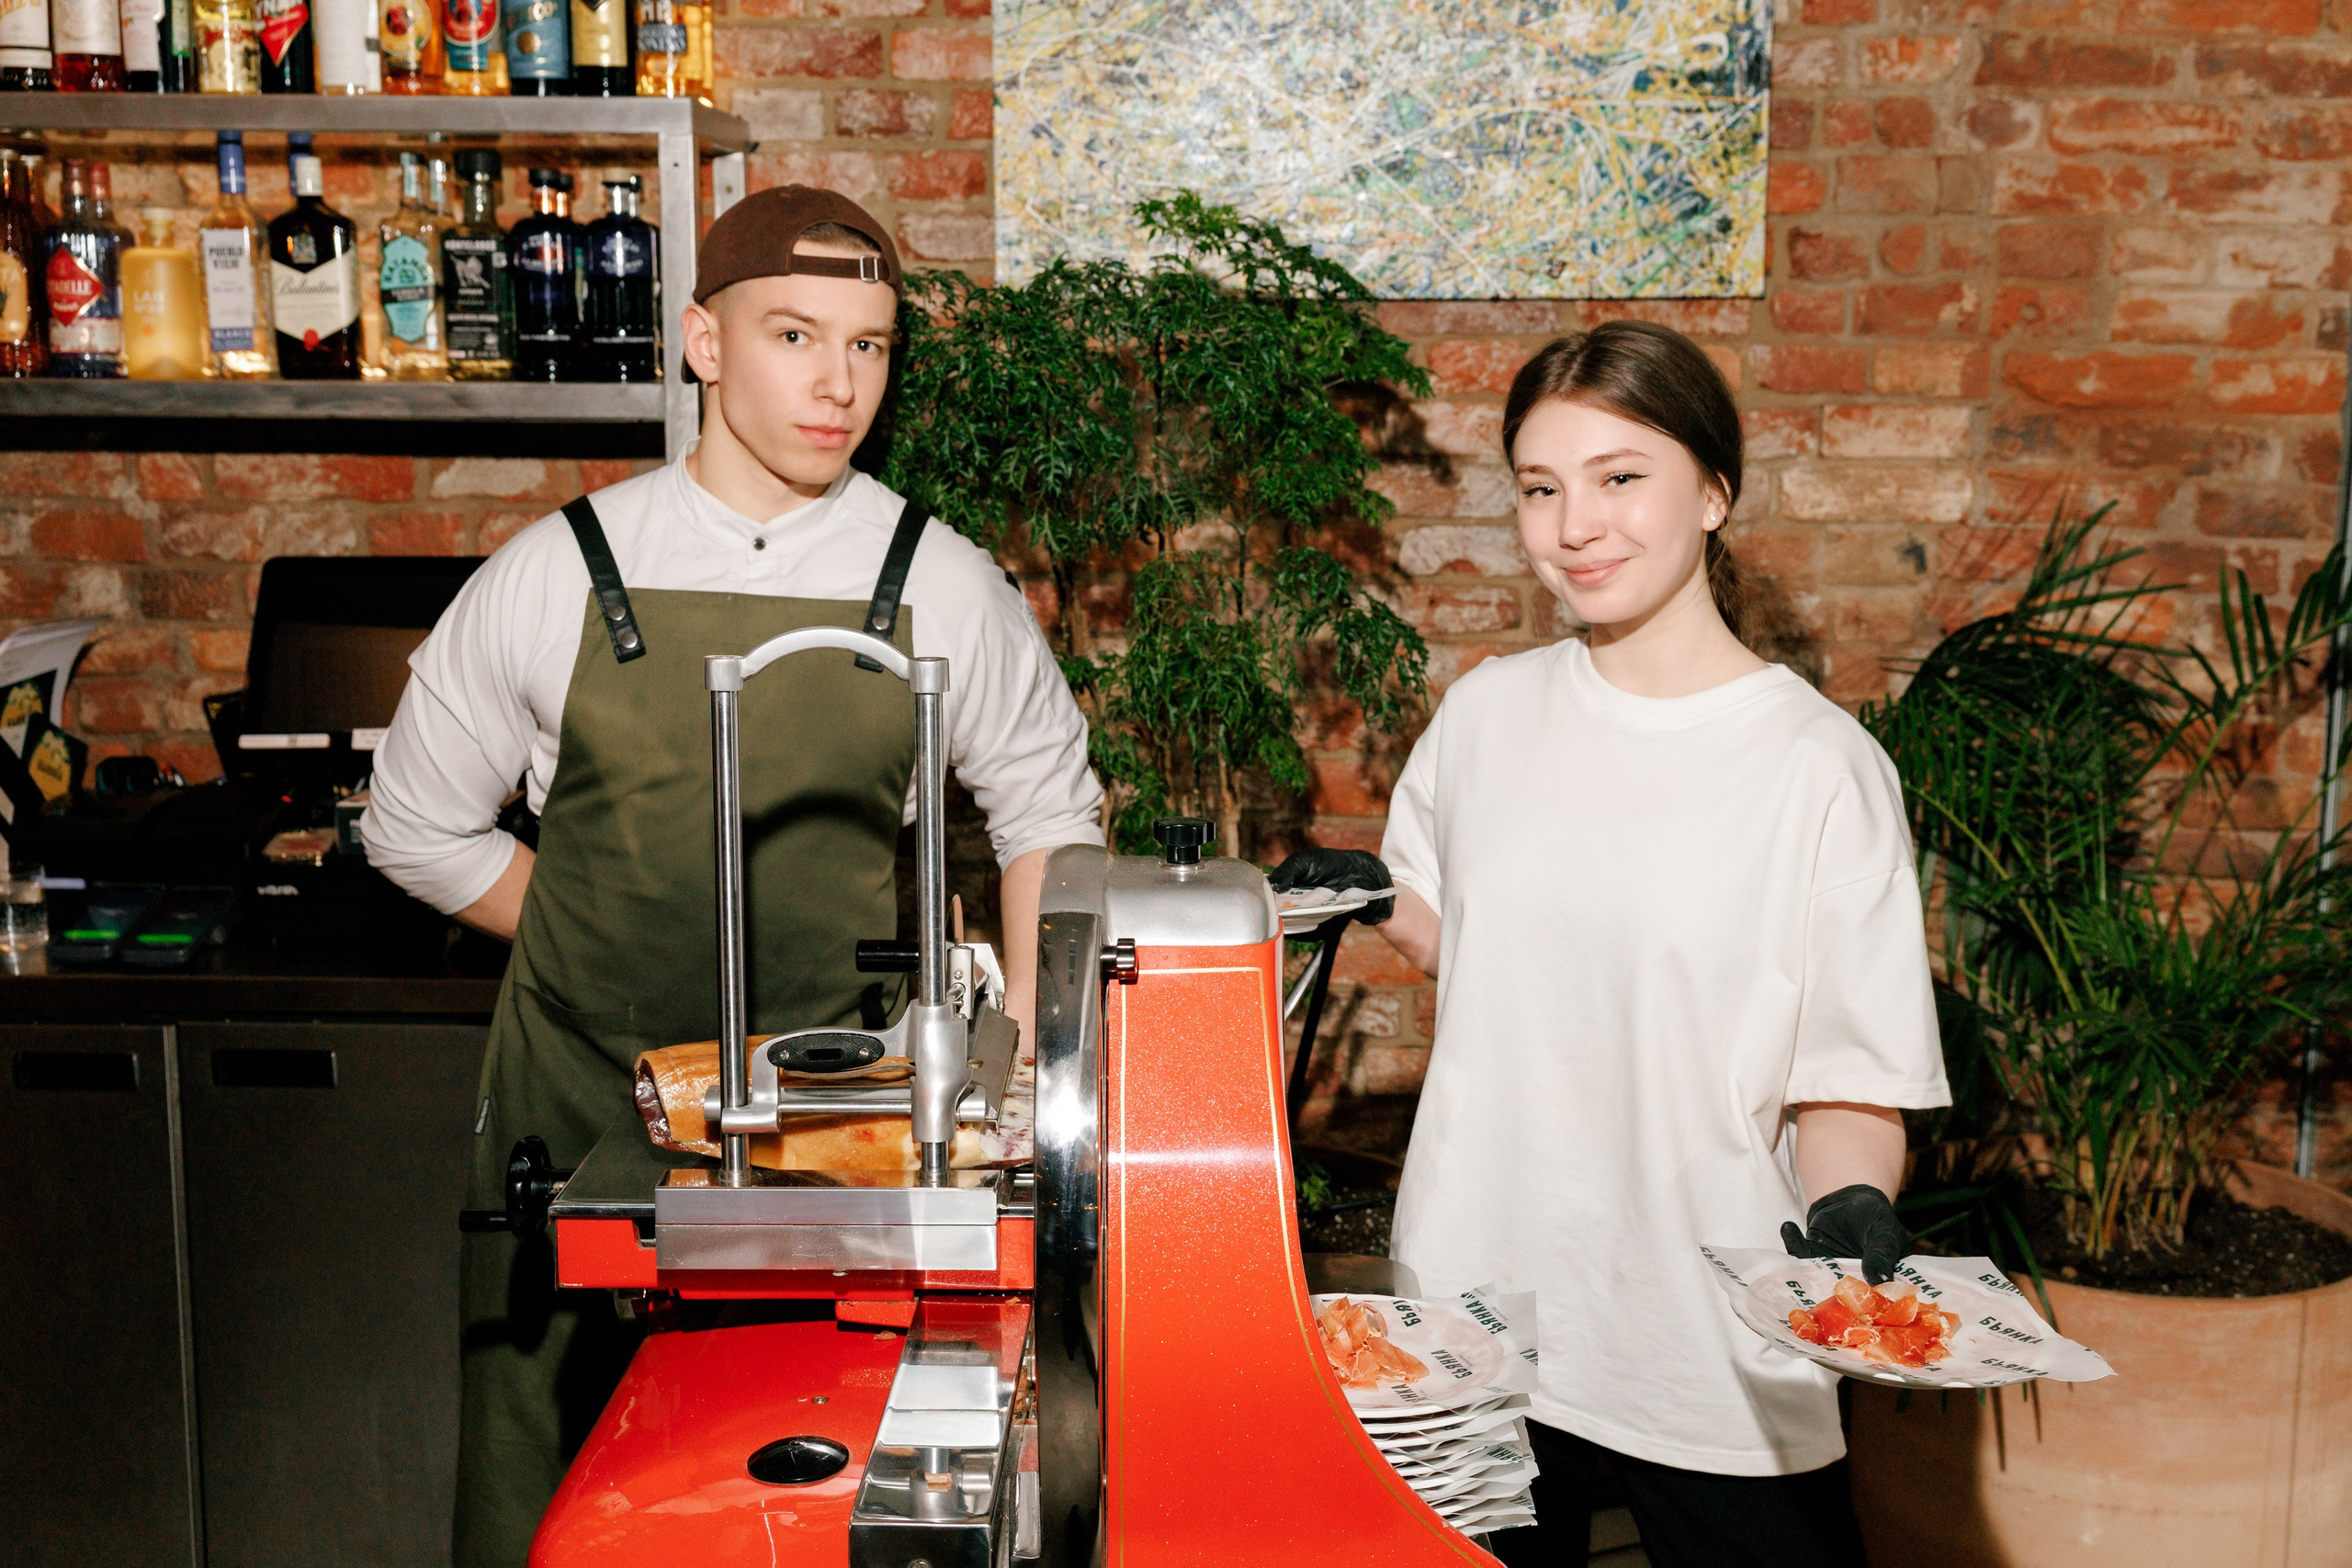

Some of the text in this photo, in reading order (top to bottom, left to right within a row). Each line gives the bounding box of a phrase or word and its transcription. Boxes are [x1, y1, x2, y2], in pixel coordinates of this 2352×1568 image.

[1894, 1262, 1943, 1299] ЬЯНКА
[1464, 1300, 1509, 1335] БЬЯНКА
[1978, 1315, 2044, 1345] БЬЯНКА
[1430, 1348, 1473, 1380] БЬЯНКА
[1980, 1358, 2050, 1376] БЬЯНКА
